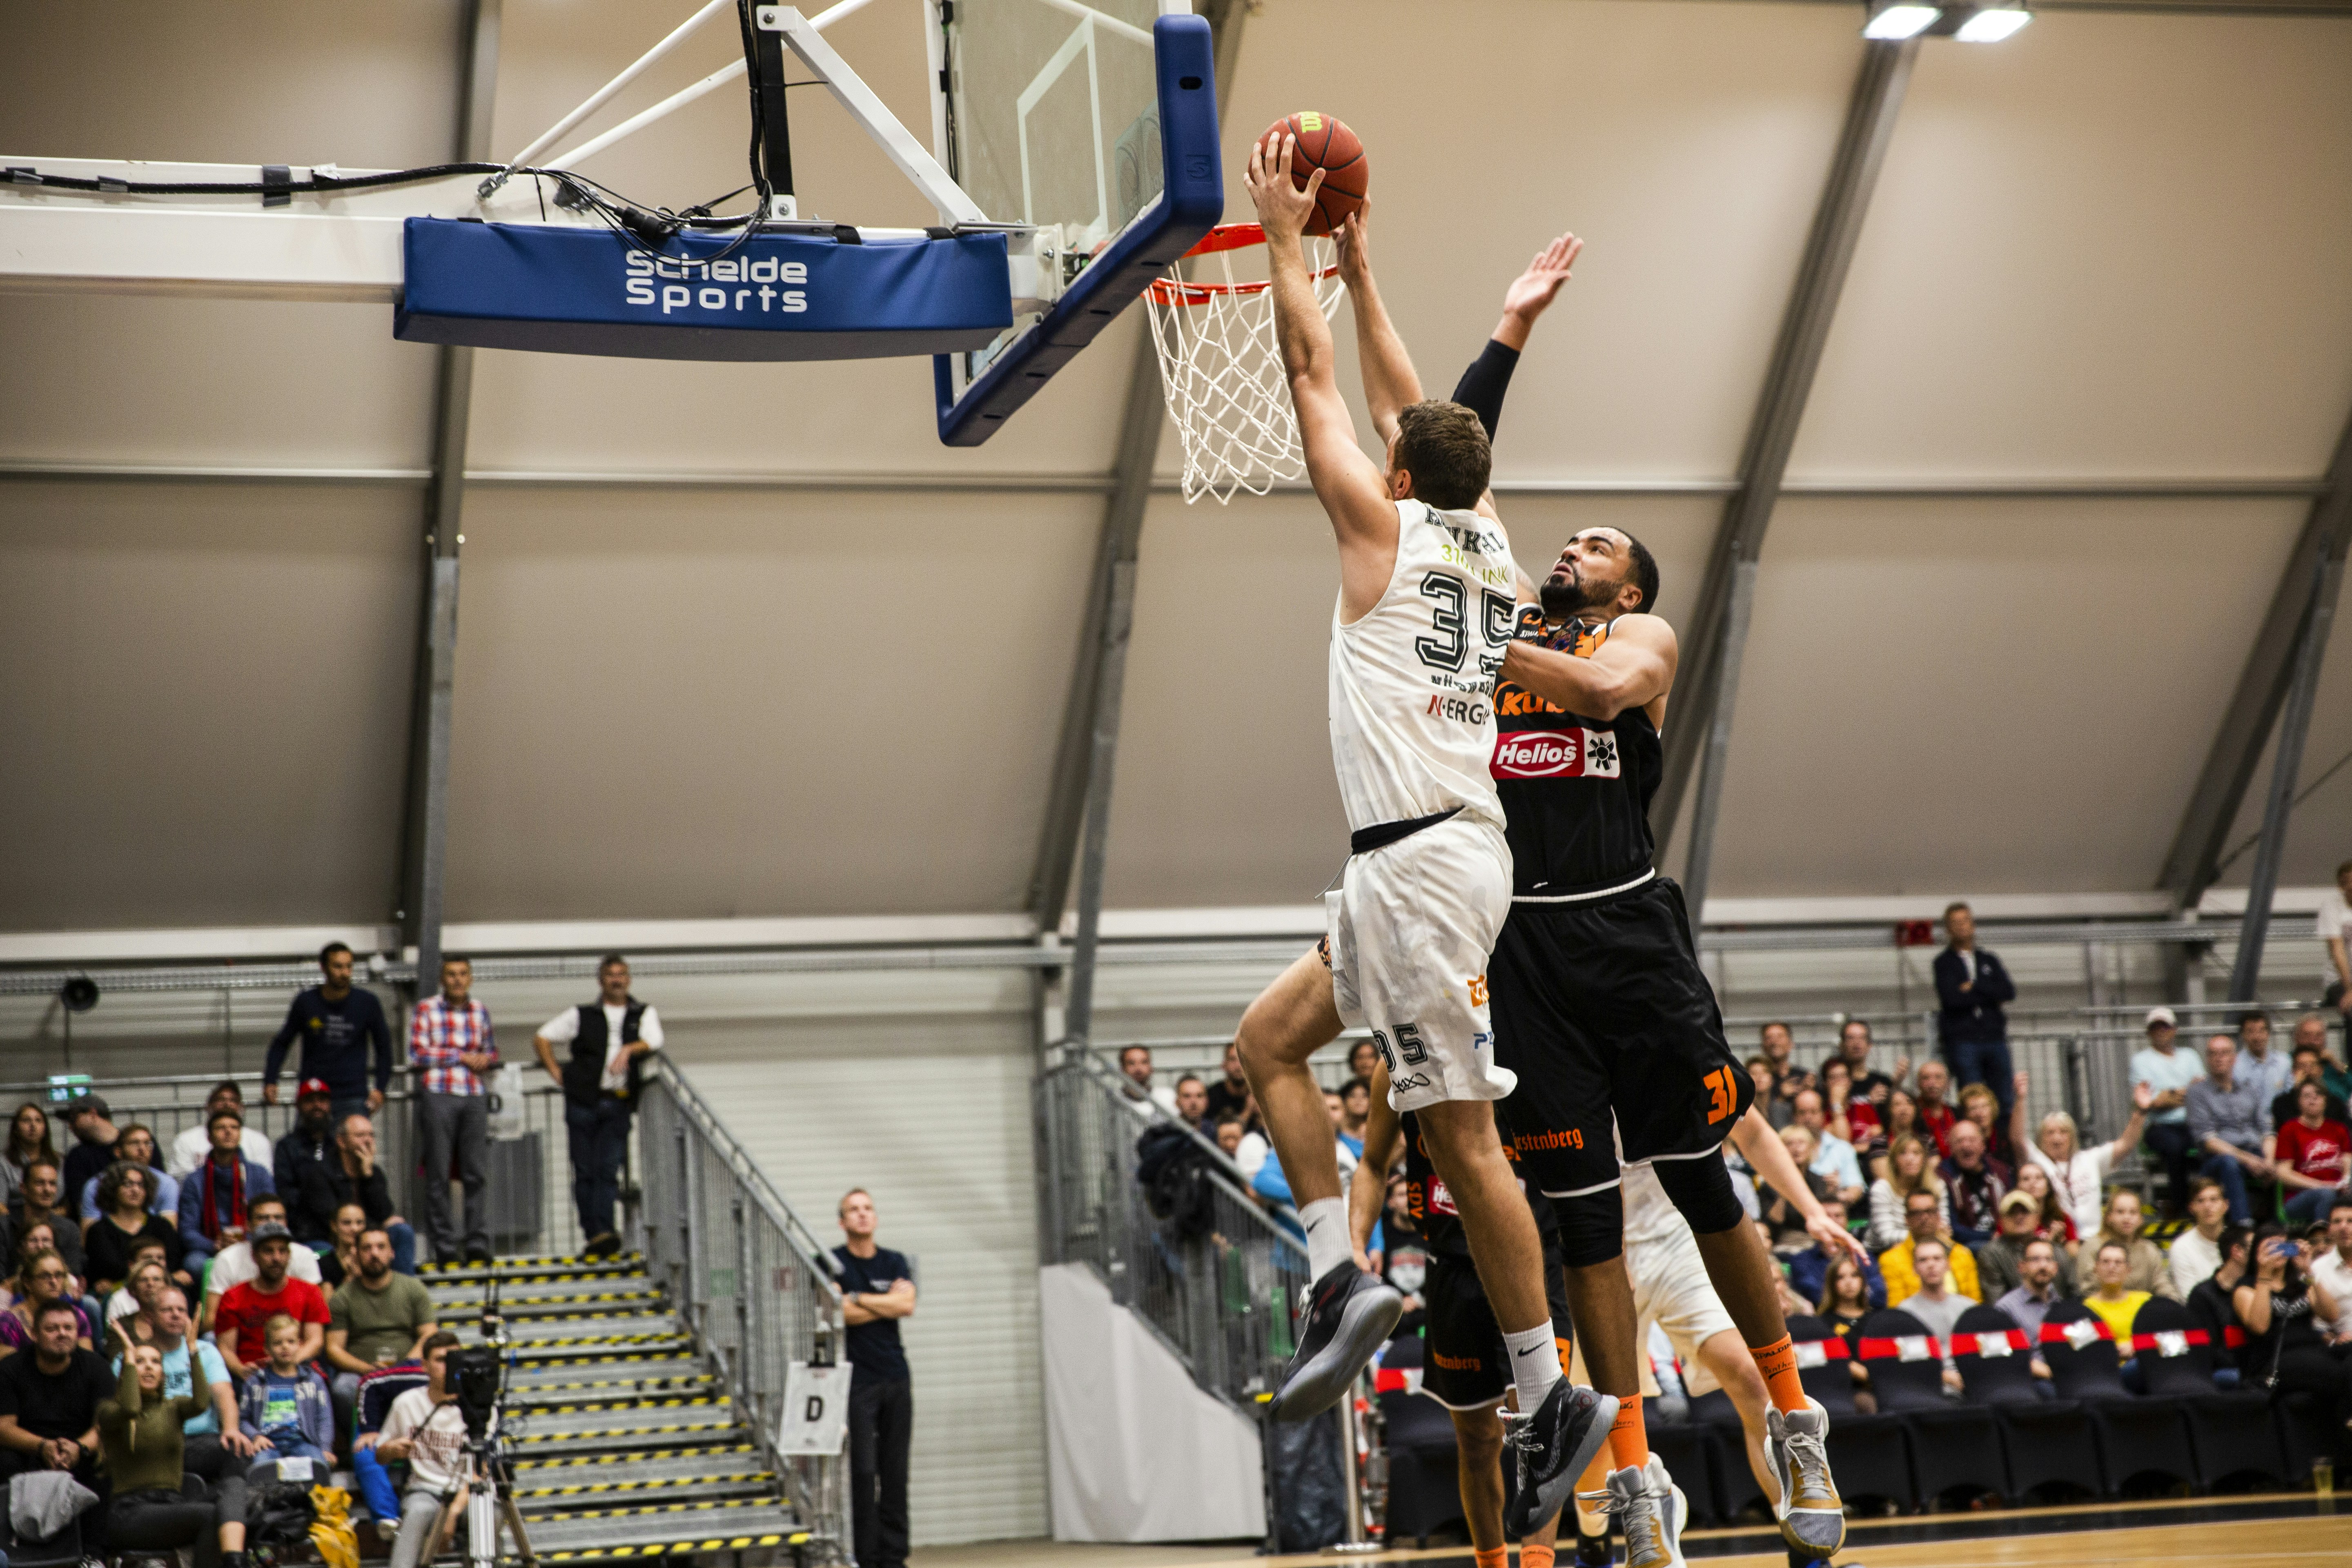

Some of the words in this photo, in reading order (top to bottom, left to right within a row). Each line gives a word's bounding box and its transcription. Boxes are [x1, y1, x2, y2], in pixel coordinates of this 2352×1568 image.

[626, 249, 807, 284] Schelde
[626, 278, 807, 314] Sports
[1415, 571, 1517, 677] 35
[1496, 743, 1577, 765] Helios
[1703, 1064, 1737, 1125] 31
[805, 1395, 824, 1422] D
